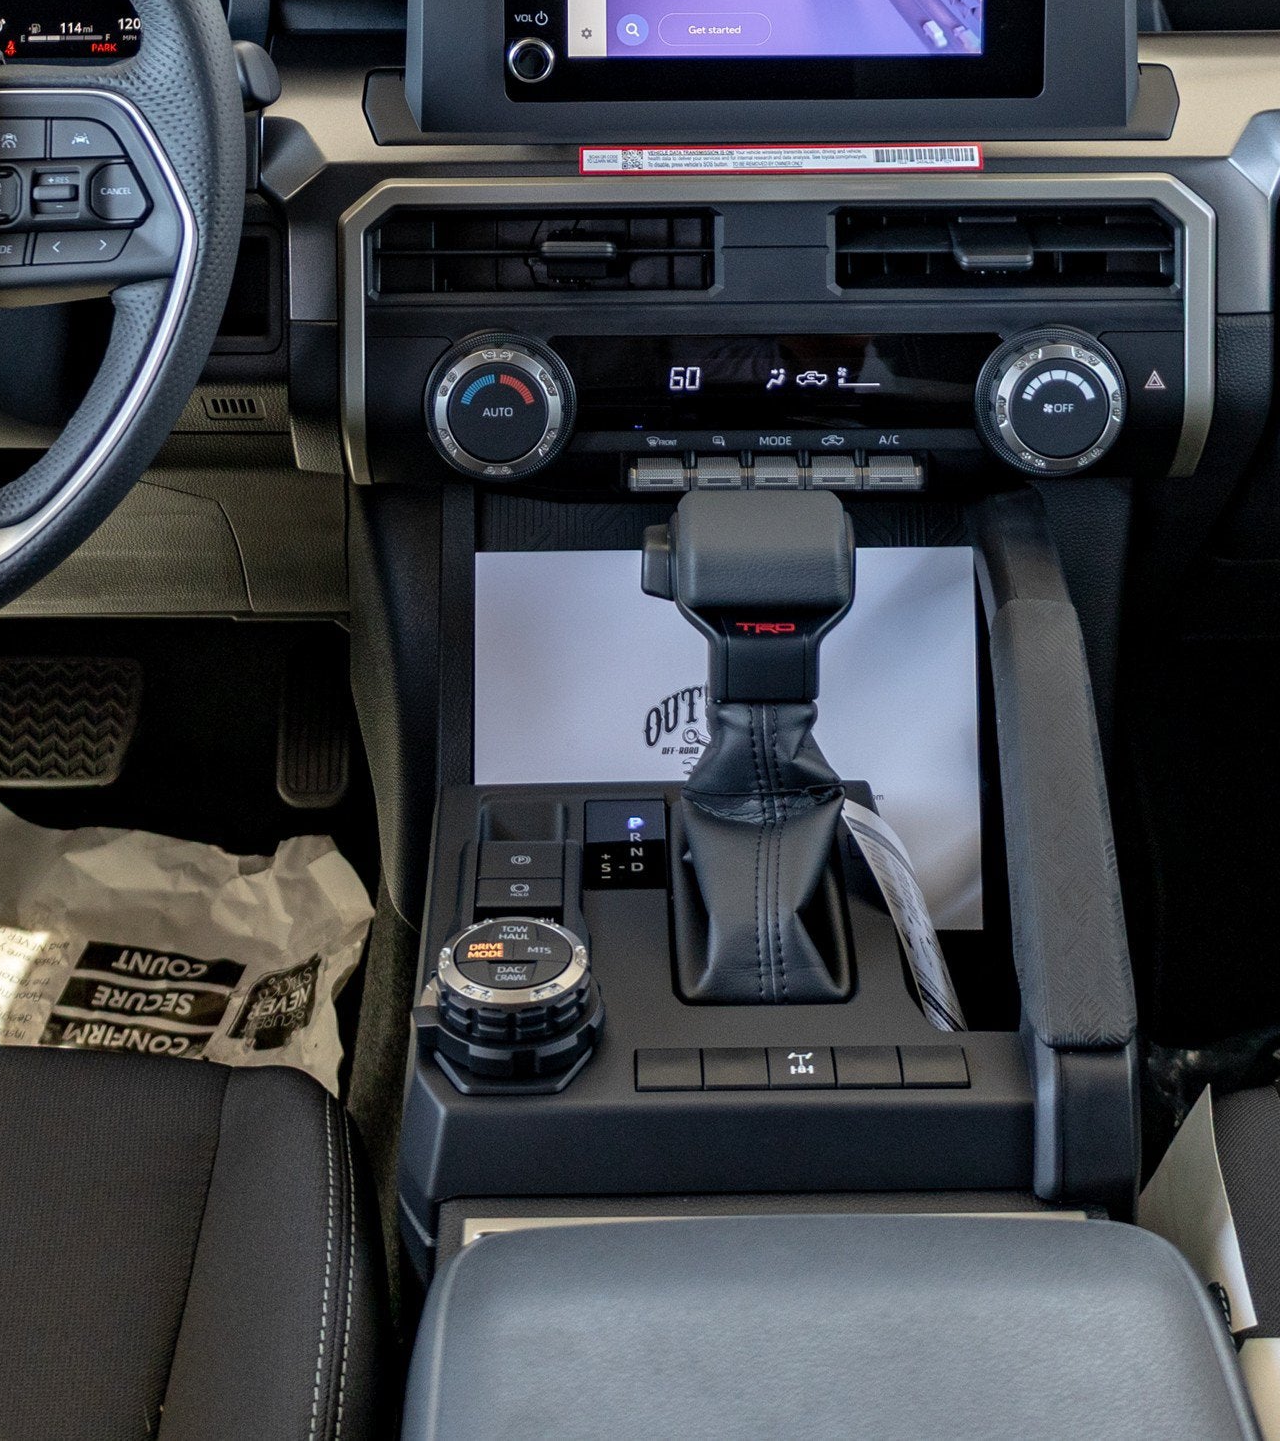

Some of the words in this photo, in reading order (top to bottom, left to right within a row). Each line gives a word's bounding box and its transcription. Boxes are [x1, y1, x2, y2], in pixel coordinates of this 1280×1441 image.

[513, 13, 533, 23] VOL
[60, 22, 82, 33] 114
[82, 24, 94, 33] mi
[117, 17, 141, 30] 120
[687, 24, 707, 36] Get
[708, 23, 742, 37] started
[91, 43, 117, 52] PARK
[100, 187, 132, 195] CANCEL
[669, 366, 701, 390] 60
[482, 407, 513, 417] AUTO
[1053, 403, 1074, 413] OFF
[659, 438, 678, 446] FRONT
[759, 436, 792, 446] MODE
[879, 434, 900, 445] A/C
[735, 622, 796, 634] TRD
[661, 746, 700, 755] OFF-ROAD
[627, 816, 644, 830] P
[629, 832, 642, 842] R
[630, 847, 644, 857] N
[601, 863, 612, 873] S
[631, 863, 644, 872] D
[501, 925, 529, 933] TOW
[498, 932, 530, 941] HAUL
[469, 942, 504, 951] DRIVE
[527, 946, 552, 954] MTS
[467, 950, 504, 959] MODE
[111, 949, 208, 979] COUNT
[496, 966, 528, 974] DAC/
[494, 973, 528, 982] CRAWL
[91, 984, 196, 1016] SECURE
[247, 984, 312, 1020] NEVER
[61, 1021, 191, 1056] CONFIRM
